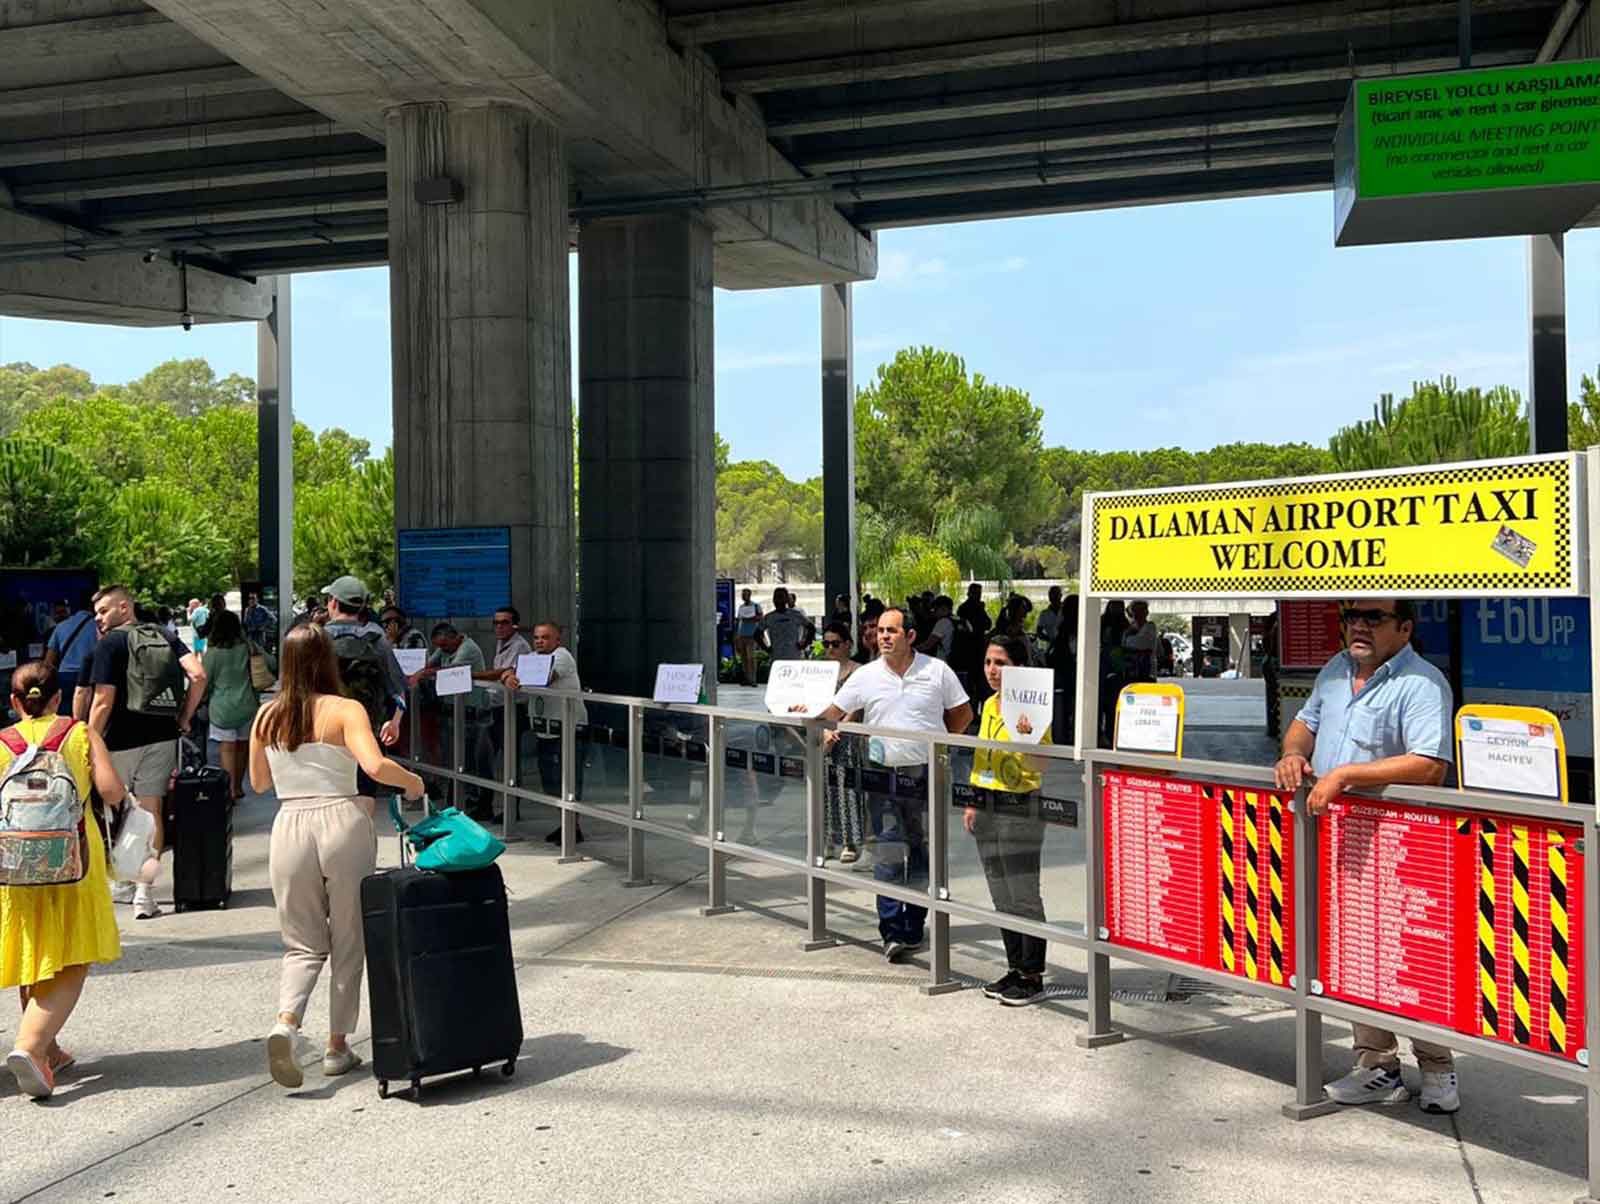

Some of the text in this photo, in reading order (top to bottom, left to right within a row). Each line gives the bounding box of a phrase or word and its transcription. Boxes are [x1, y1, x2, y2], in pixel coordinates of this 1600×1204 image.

[1446, 84, 1499, 99] YOLCU
[1469, 103, 1497, 116] rent
[1502, 104, 1511, 113] a
[1515, 101, 1537, 112] car
[1373, 129, 1464, 150] INDIVIDUAL
[1470, 122, 1544, 142] MEETING
[1492, 143, 1520, 158] and
[1522, 141, 1552, 155] rent
[1553, 143, 1564, 153] a
[1568, 140, 1590, 153] car
[1110, 488, 1538, 541] DALAMAN AIRPORT TAXI
[1211, 538, 1386, 571] WELCOME
[1041, 799, 1065, 812] YDA
[1403, 811, 1440, 825] ROUTES
